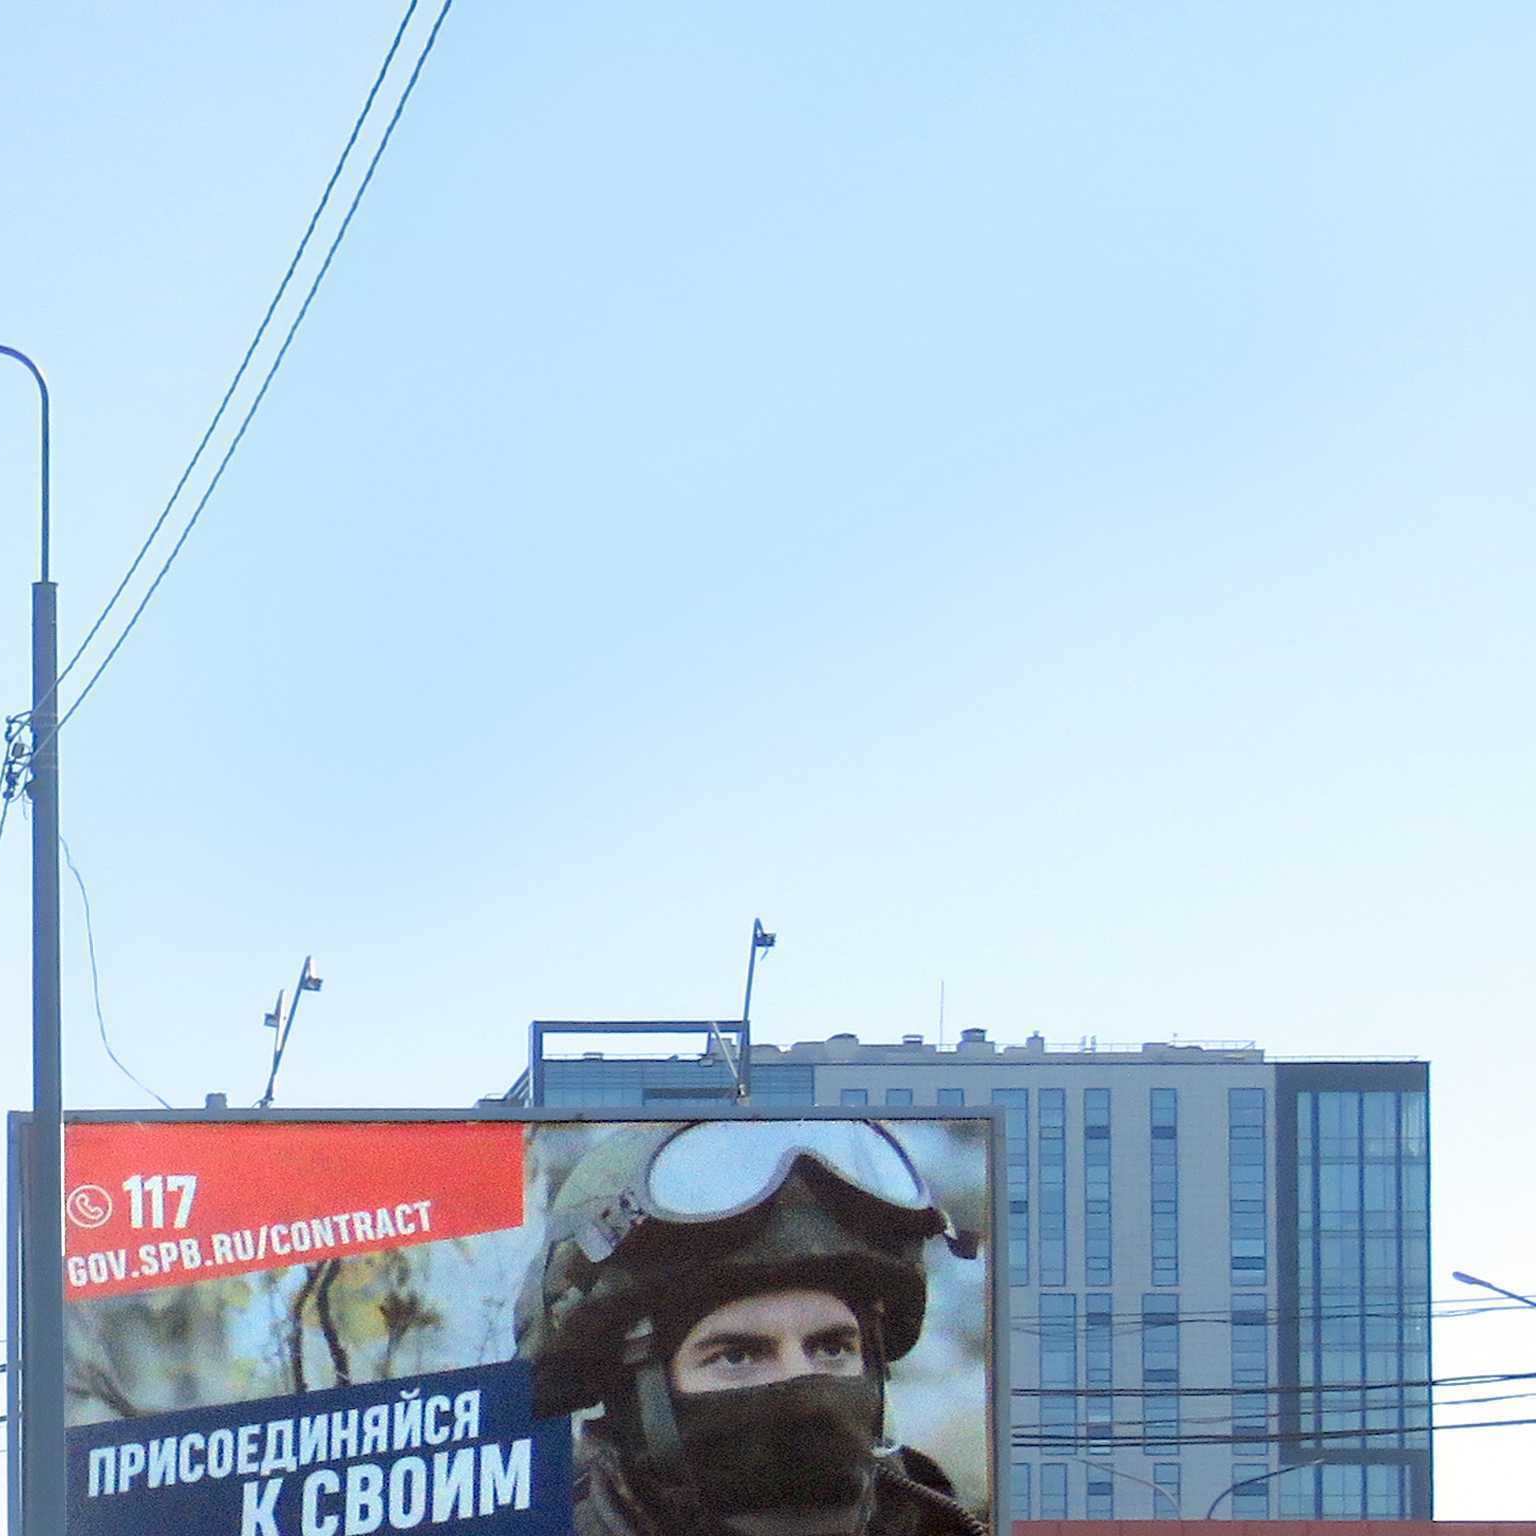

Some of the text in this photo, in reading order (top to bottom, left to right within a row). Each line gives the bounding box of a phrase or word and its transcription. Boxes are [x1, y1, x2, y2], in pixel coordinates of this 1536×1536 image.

[67, 1200, 431, 1288] GOV.SPB.RU/CONTRACT
[123, 1174, 196, 1229] 117
[87, 1388, 481, 1498] ПРИСОЕДИНЯЙСЯ
